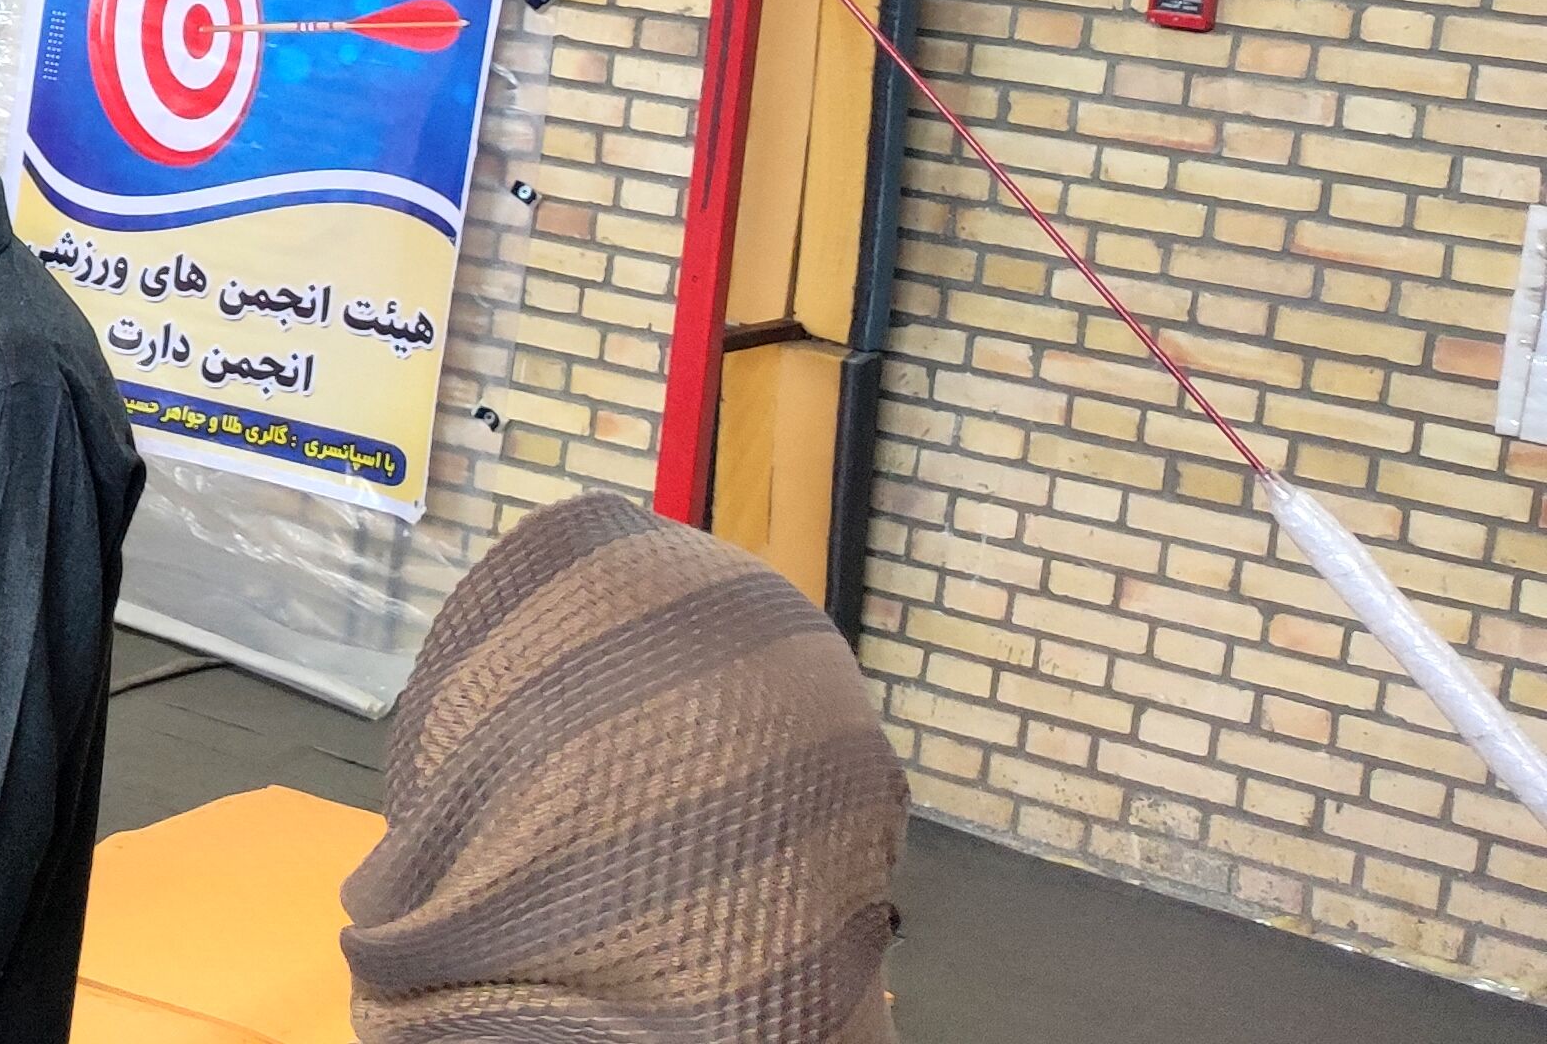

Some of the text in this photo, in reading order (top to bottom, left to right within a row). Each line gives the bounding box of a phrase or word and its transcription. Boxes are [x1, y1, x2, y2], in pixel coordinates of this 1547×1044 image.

[140, 253, 208, 298] های
[219, 278, 332, 327] انجمن
[342, 299, 435, 354] هیئت
[108, 317, 315, 395] انجمن دارت
[122, 397, 160, 415] حسی
[159, 405, 207, 430] جواهر
[207, 416, 219, 434] و
[220, 413, 243, 435] طلا
[244, 424, 289, 445] گالری
[303, 438, 382, 471] اسپانسری
[384, 452, 397, 478] با
